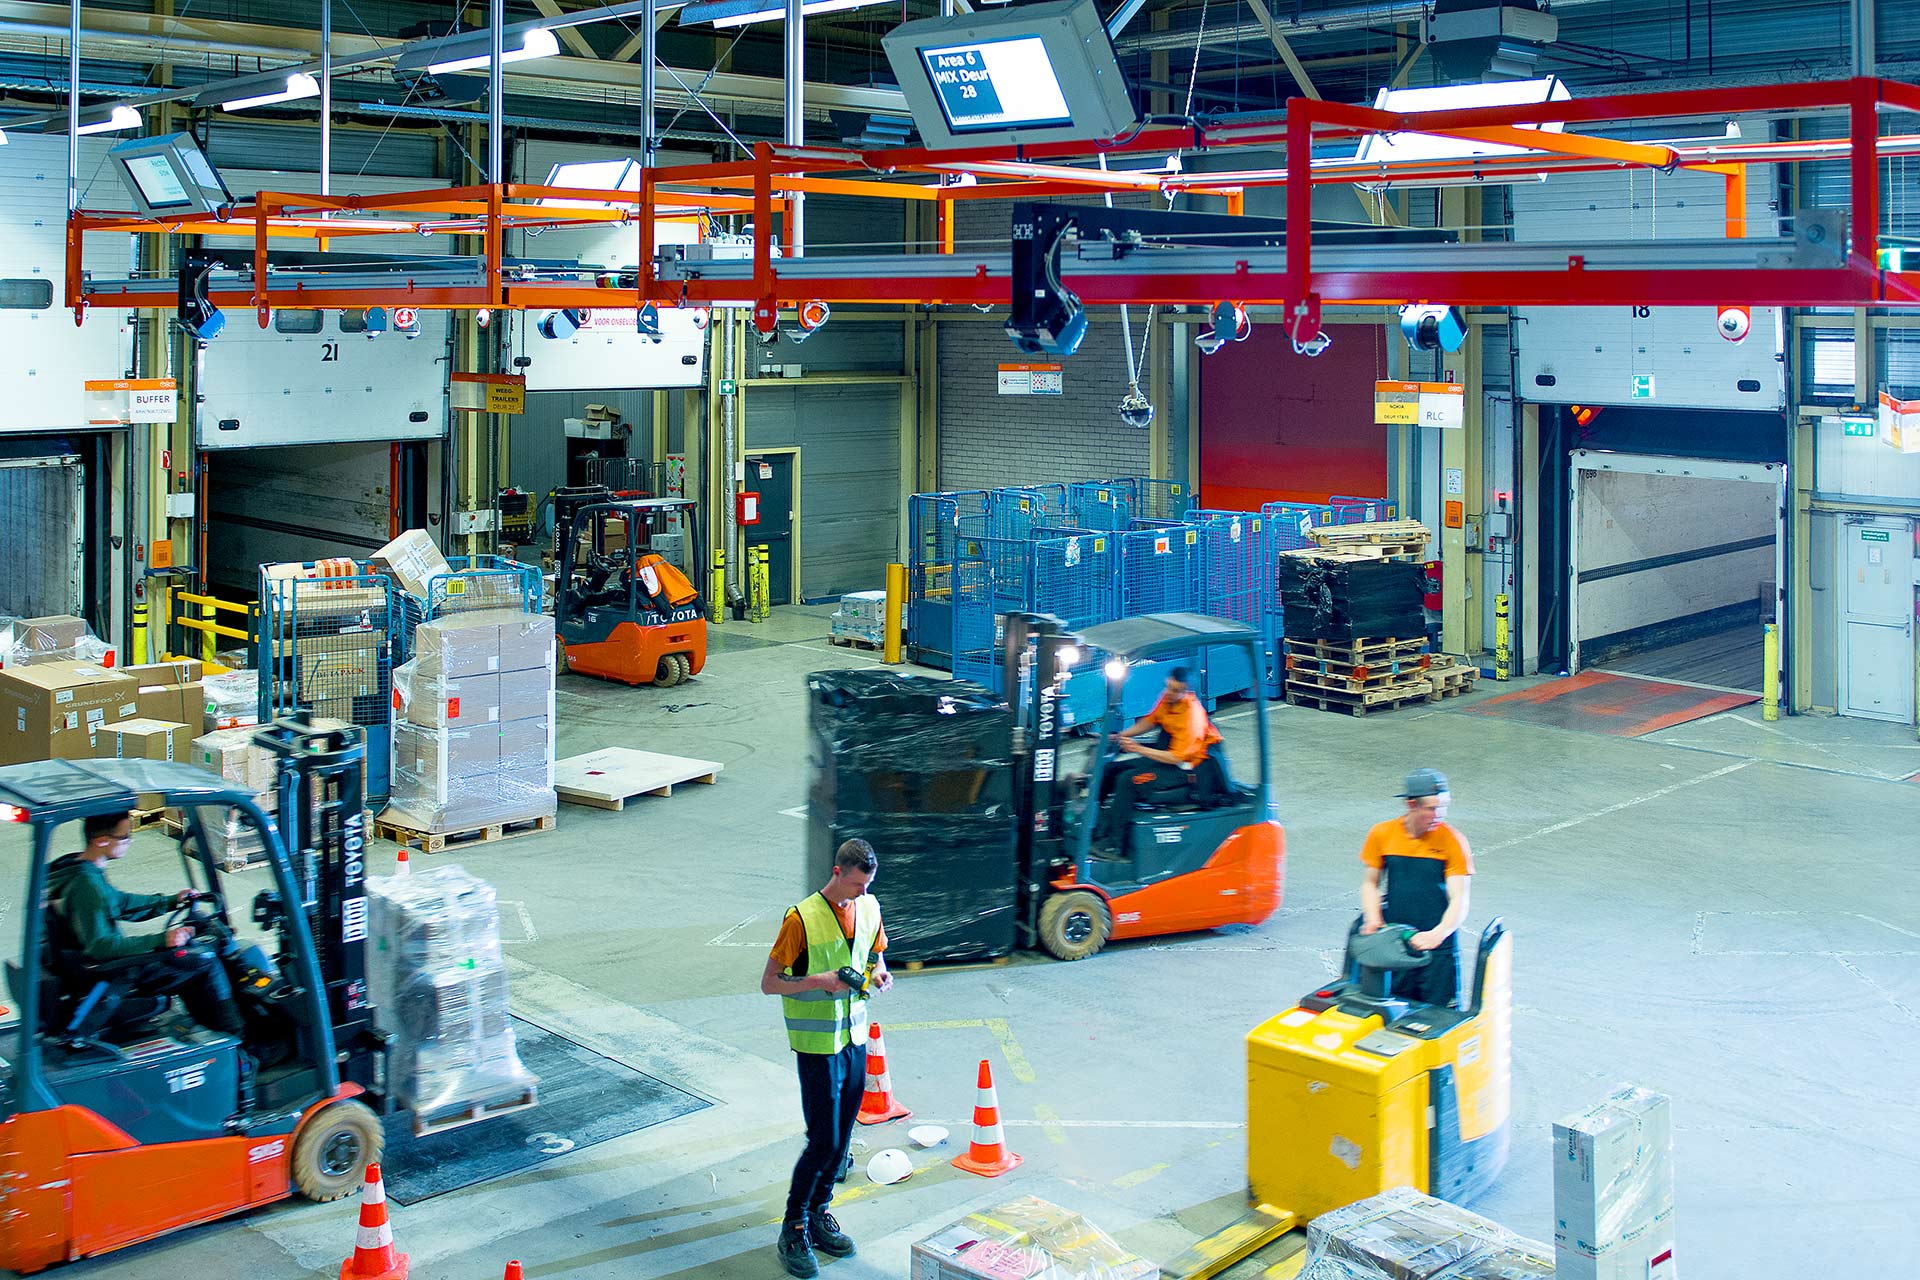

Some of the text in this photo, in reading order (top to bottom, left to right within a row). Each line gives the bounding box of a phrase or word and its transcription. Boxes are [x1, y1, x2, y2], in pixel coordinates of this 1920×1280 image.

[939, 52, 975, 69] Area 6
[936, 69, 988, 84] MIX Deur
[960, 85, 977, 98] 28
[1632, 305, 1650, 318] 18
[594, 317, 610, 326] VOOR
[321, 343, 339, 361] 21
[136, 395, 170, 404] BUFFER
[1426, 411, 1445, 421] RLC
[65, 697, 113, 709] GRUNDFOS
[1039, 685, 1056, 740] TOYOTA
[343, 812, 364, 888] TOYOTA
[525, 1131, 575, 1155] 3
